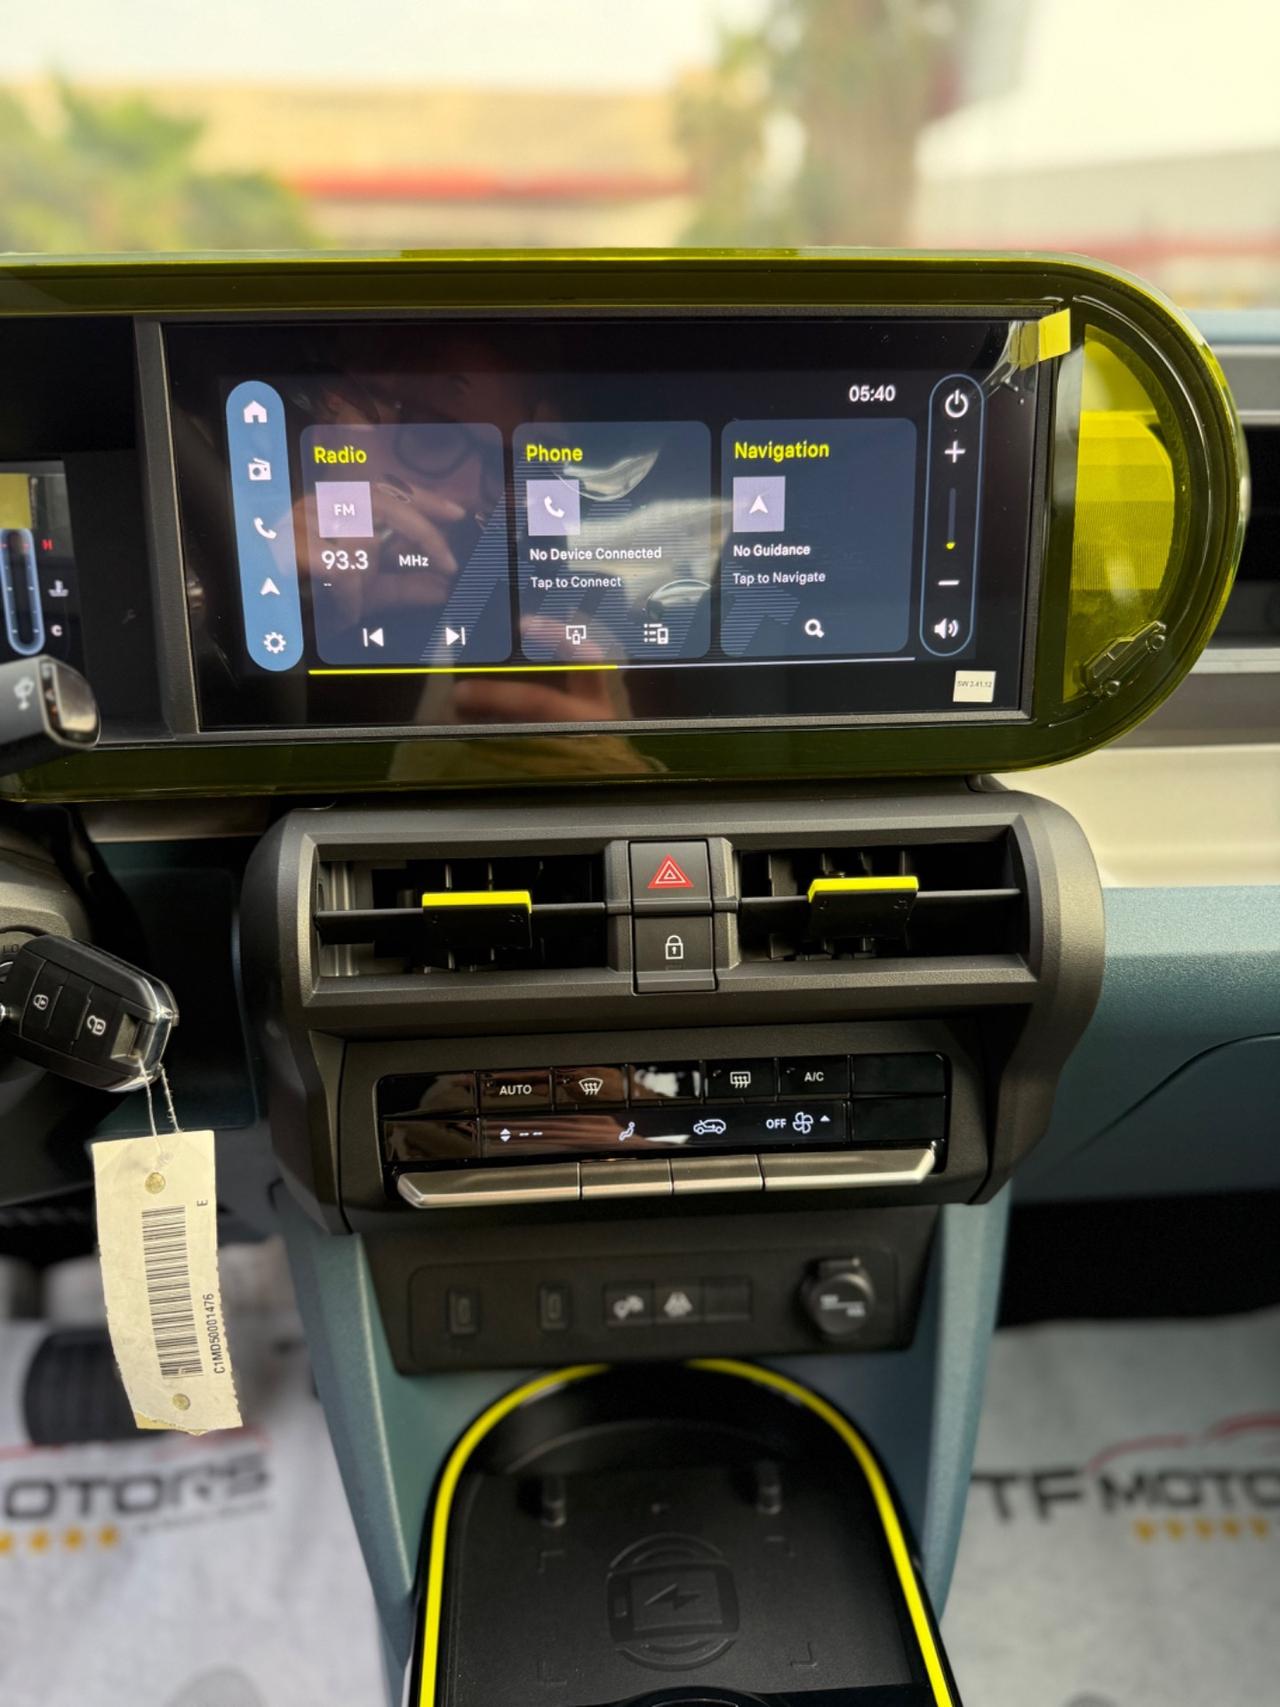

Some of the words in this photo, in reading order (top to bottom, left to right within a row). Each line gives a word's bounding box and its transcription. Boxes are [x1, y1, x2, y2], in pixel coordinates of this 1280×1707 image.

[848, 383, 896, 402] 05:40
[313, 445, 367, 464] Radio
[526, 443, 583, 462] Phone
[734, 440, 830, 463] Navigation
[334, 503, 355, 516] FM
[529, 548, 548, 560] No
[550, 547, 593, 560] Device
[595, 546, 662, 559] Connected
[733, 544, 751, 557] No
[753, 543, 811, 556] Guidance
[321, 549, 369, 570] 93.3
[398, 553, 429, 567] MHz
[530, 576, 553, 590] Tap
[555, 577, 569, 588] to
[571, 576, 622, 588] Connect
[732, 573, 755, 586] Tap
[757, 573, 770, 584] to
[772, 571, 826, 585] Navigate
[804, 1071, 825, 1082] A/C
[499, 1084, 533, 1096] AUTO
[765, 1118, 787, 1130] OFF
